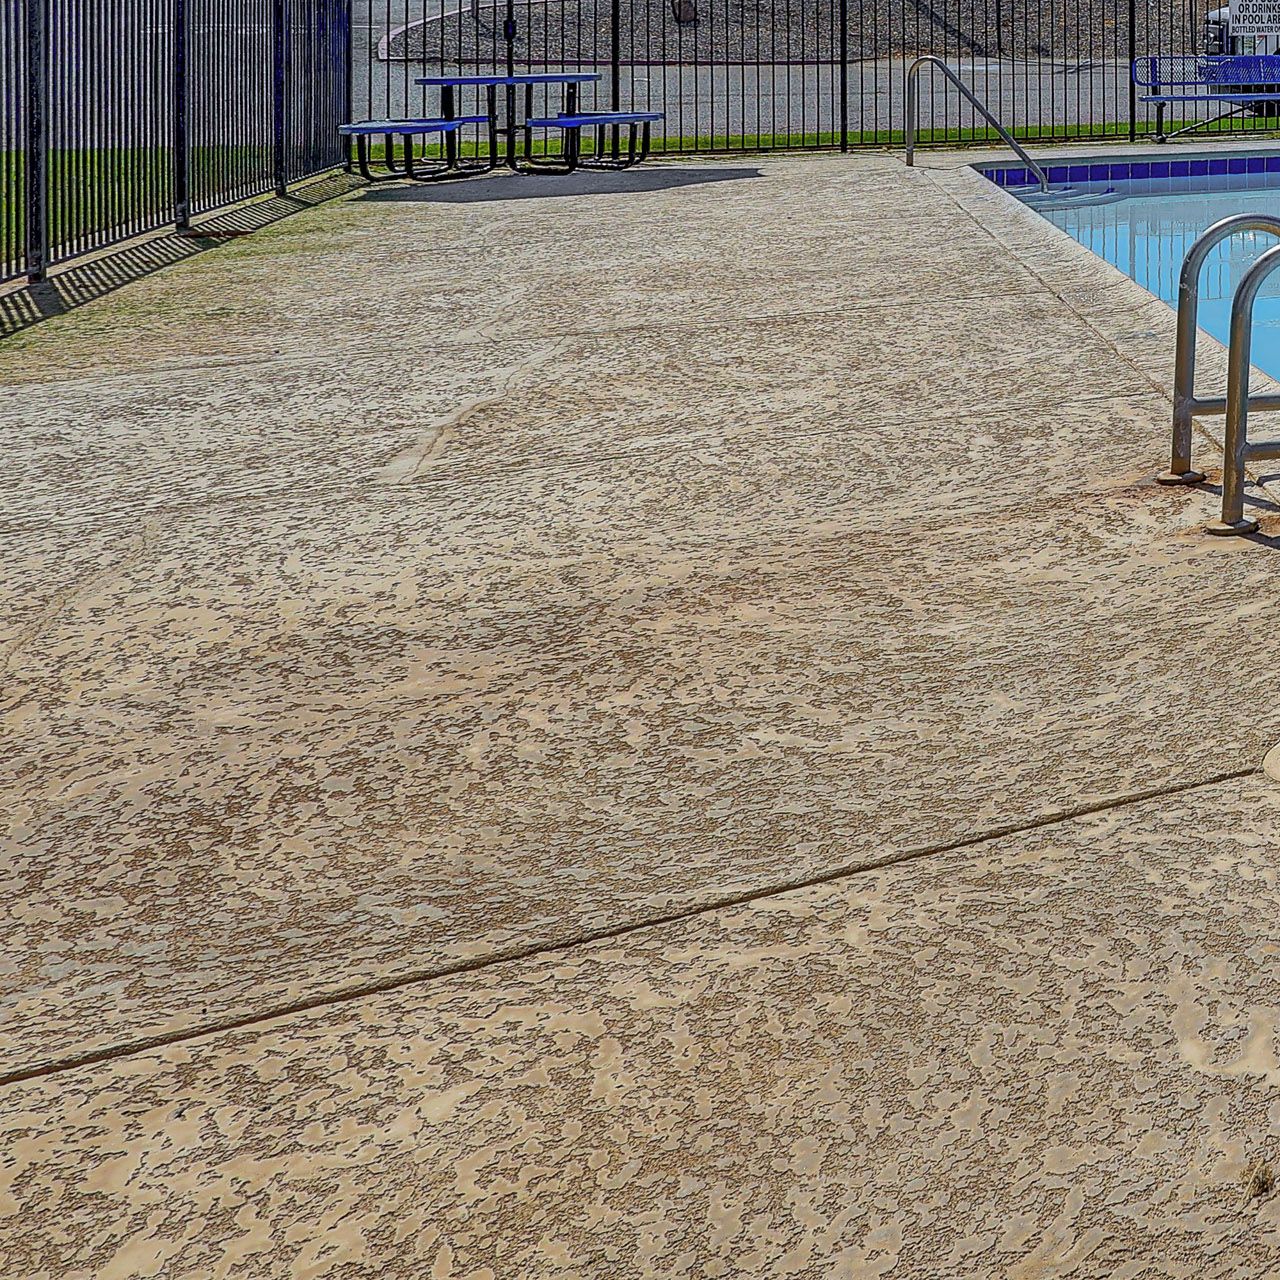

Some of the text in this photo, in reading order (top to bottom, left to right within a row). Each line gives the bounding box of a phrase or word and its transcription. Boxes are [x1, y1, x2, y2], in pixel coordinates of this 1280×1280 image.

[1238, 3, 1250, 14] OR
[1231, 14, 1241, 24] IN
[1242, 14, 1265, 24] POOL
[1231, 25, 1255, 34] BOTTLED
[1256, 25, 1274, 34] WATER
